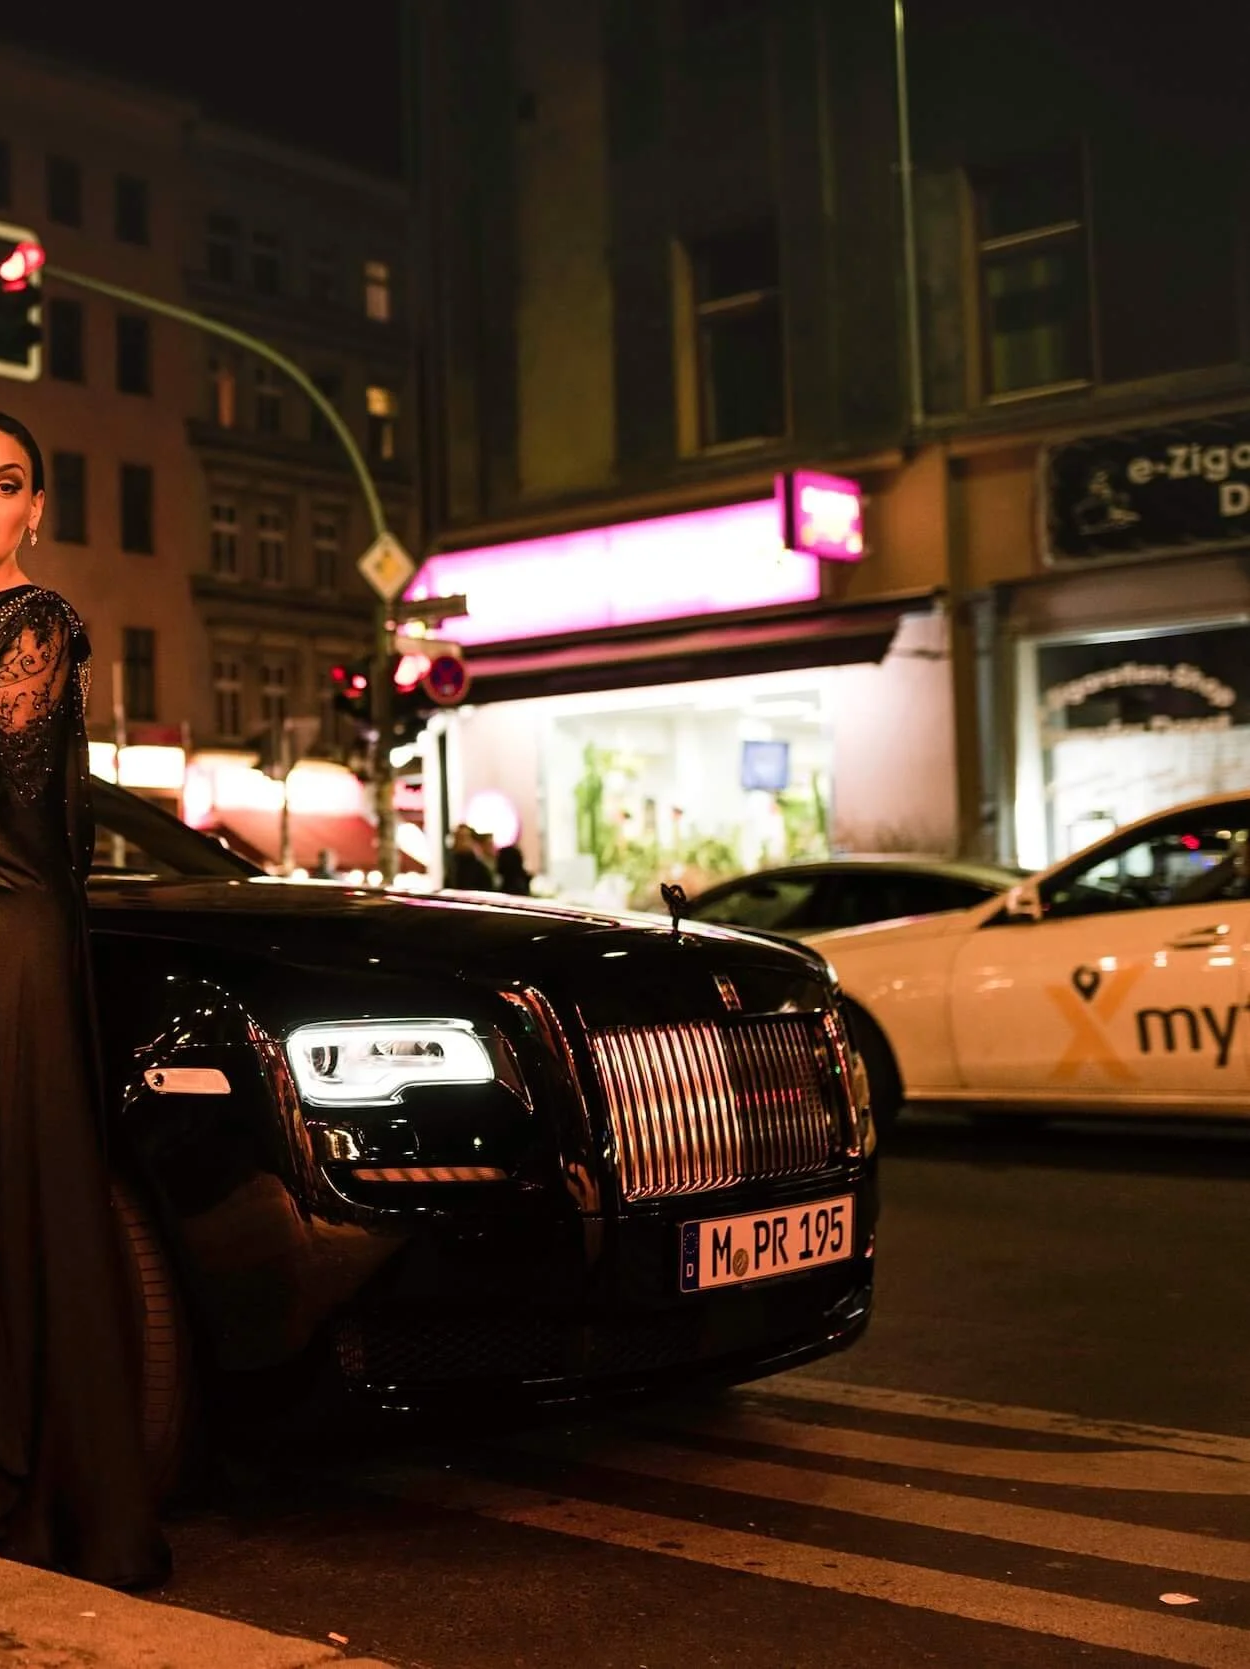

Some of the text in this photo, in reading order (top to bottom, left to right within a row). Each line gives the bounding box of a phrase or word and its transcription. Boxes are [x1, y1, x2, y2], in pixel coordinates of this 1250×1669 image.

[1136, 1002, 1250, 1070] my
[686, 1263, 695, 1278] D
[711, 1205, 845, 1278] M PR 195
